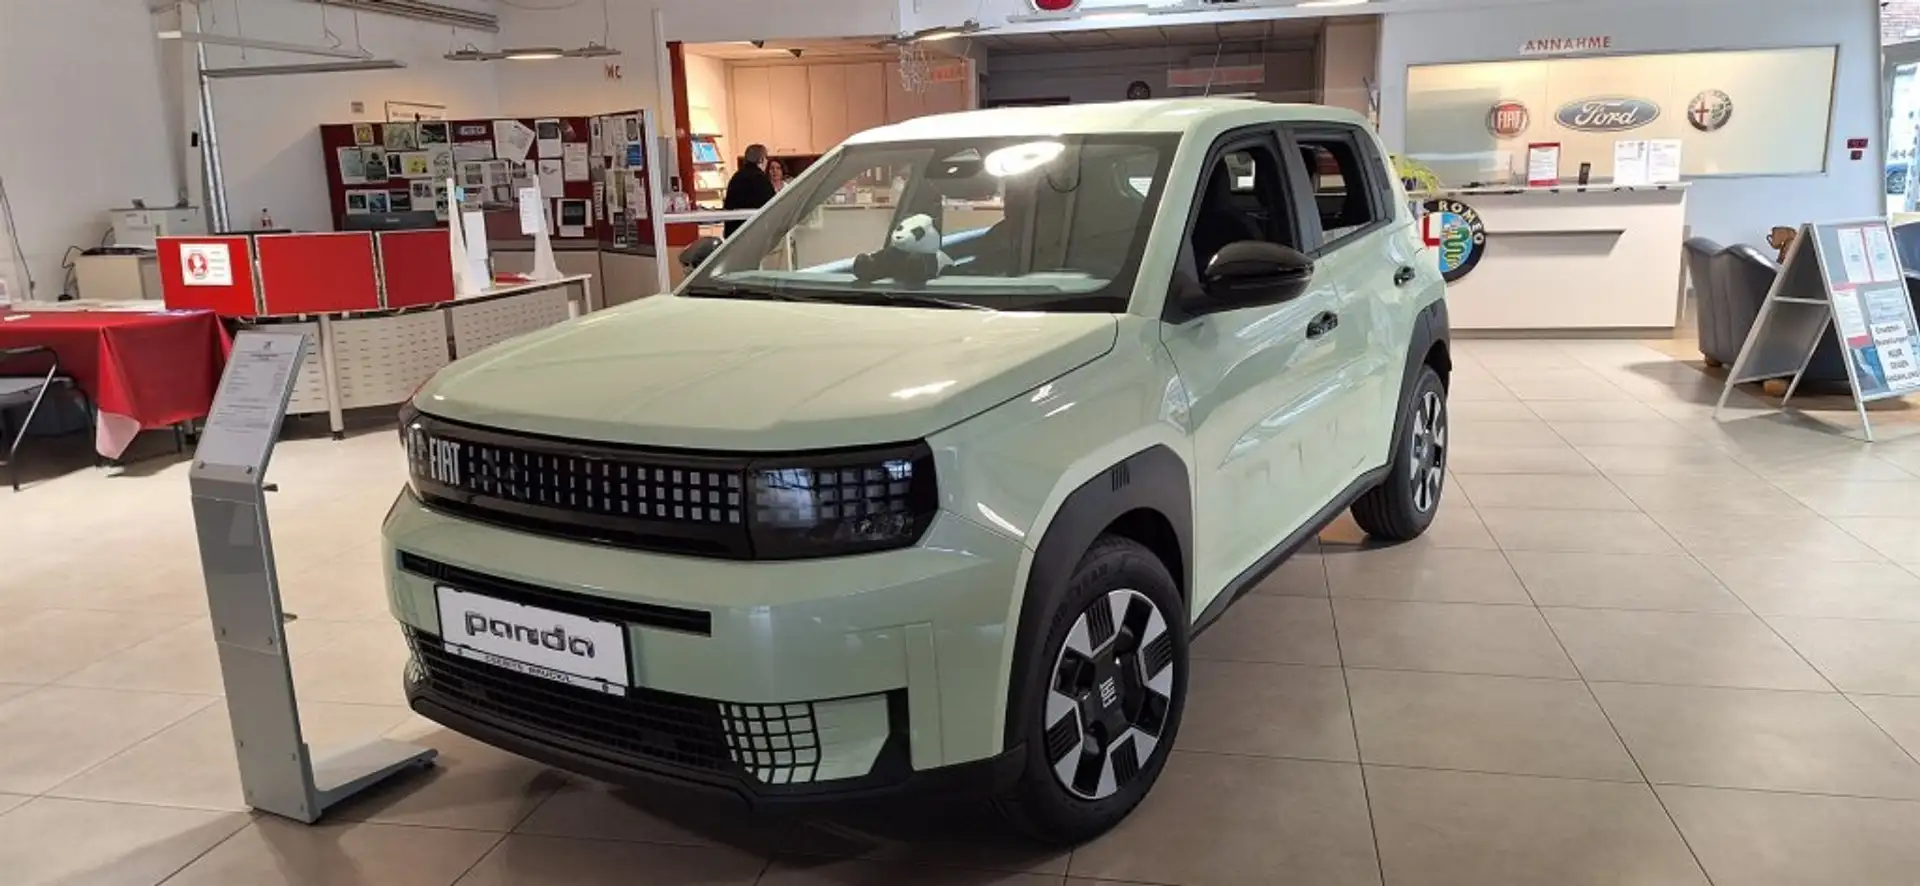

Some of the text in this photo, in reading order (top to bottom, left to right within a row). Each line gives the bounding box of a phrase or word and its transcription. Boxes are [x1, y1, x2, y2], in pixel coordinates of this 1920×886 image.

[1524, 36, 1611, 51] ANNAHME
[1498, 109, 1525, 131] FIAT
[1574, 101, 1640, 126] Ford
[1438, 200, 1485, 246] ROMEO
[429, 436, 460, 486] FIAT
[464, 609, 595, 659] panda
